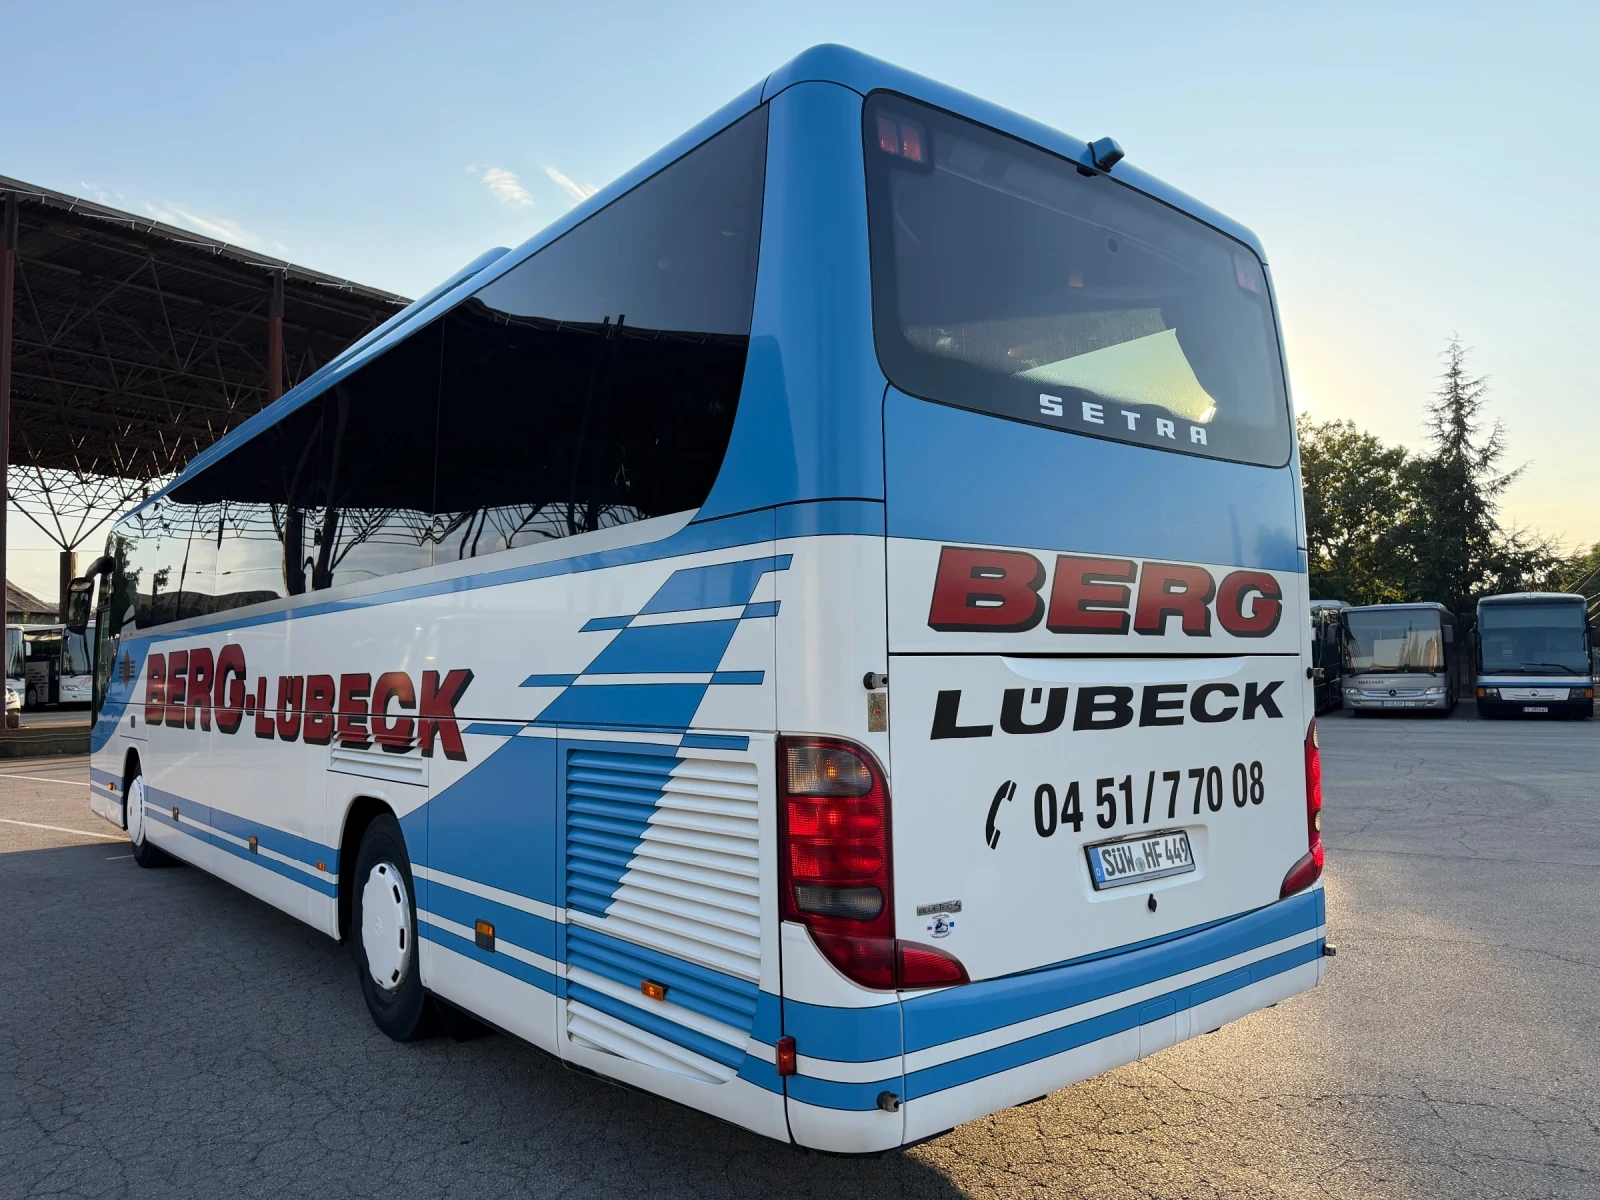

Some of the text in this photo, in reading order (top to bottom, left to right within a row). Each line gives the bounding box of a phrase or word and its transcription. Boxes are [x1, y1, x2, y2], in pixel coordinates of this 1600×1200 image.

[1039, 393, 1208, 446] SETRA
[928, 545, 1283, 638] BERG
[144, 643, 474, 762] BERG-LÜBECK
[930, 680, 1285, 740] LÜBECK
[1034, 781, 1084, 837] 04
[1232, 760, 1265, 808] 08
[1101, 837, 1189, 877] SÜW HF 449
